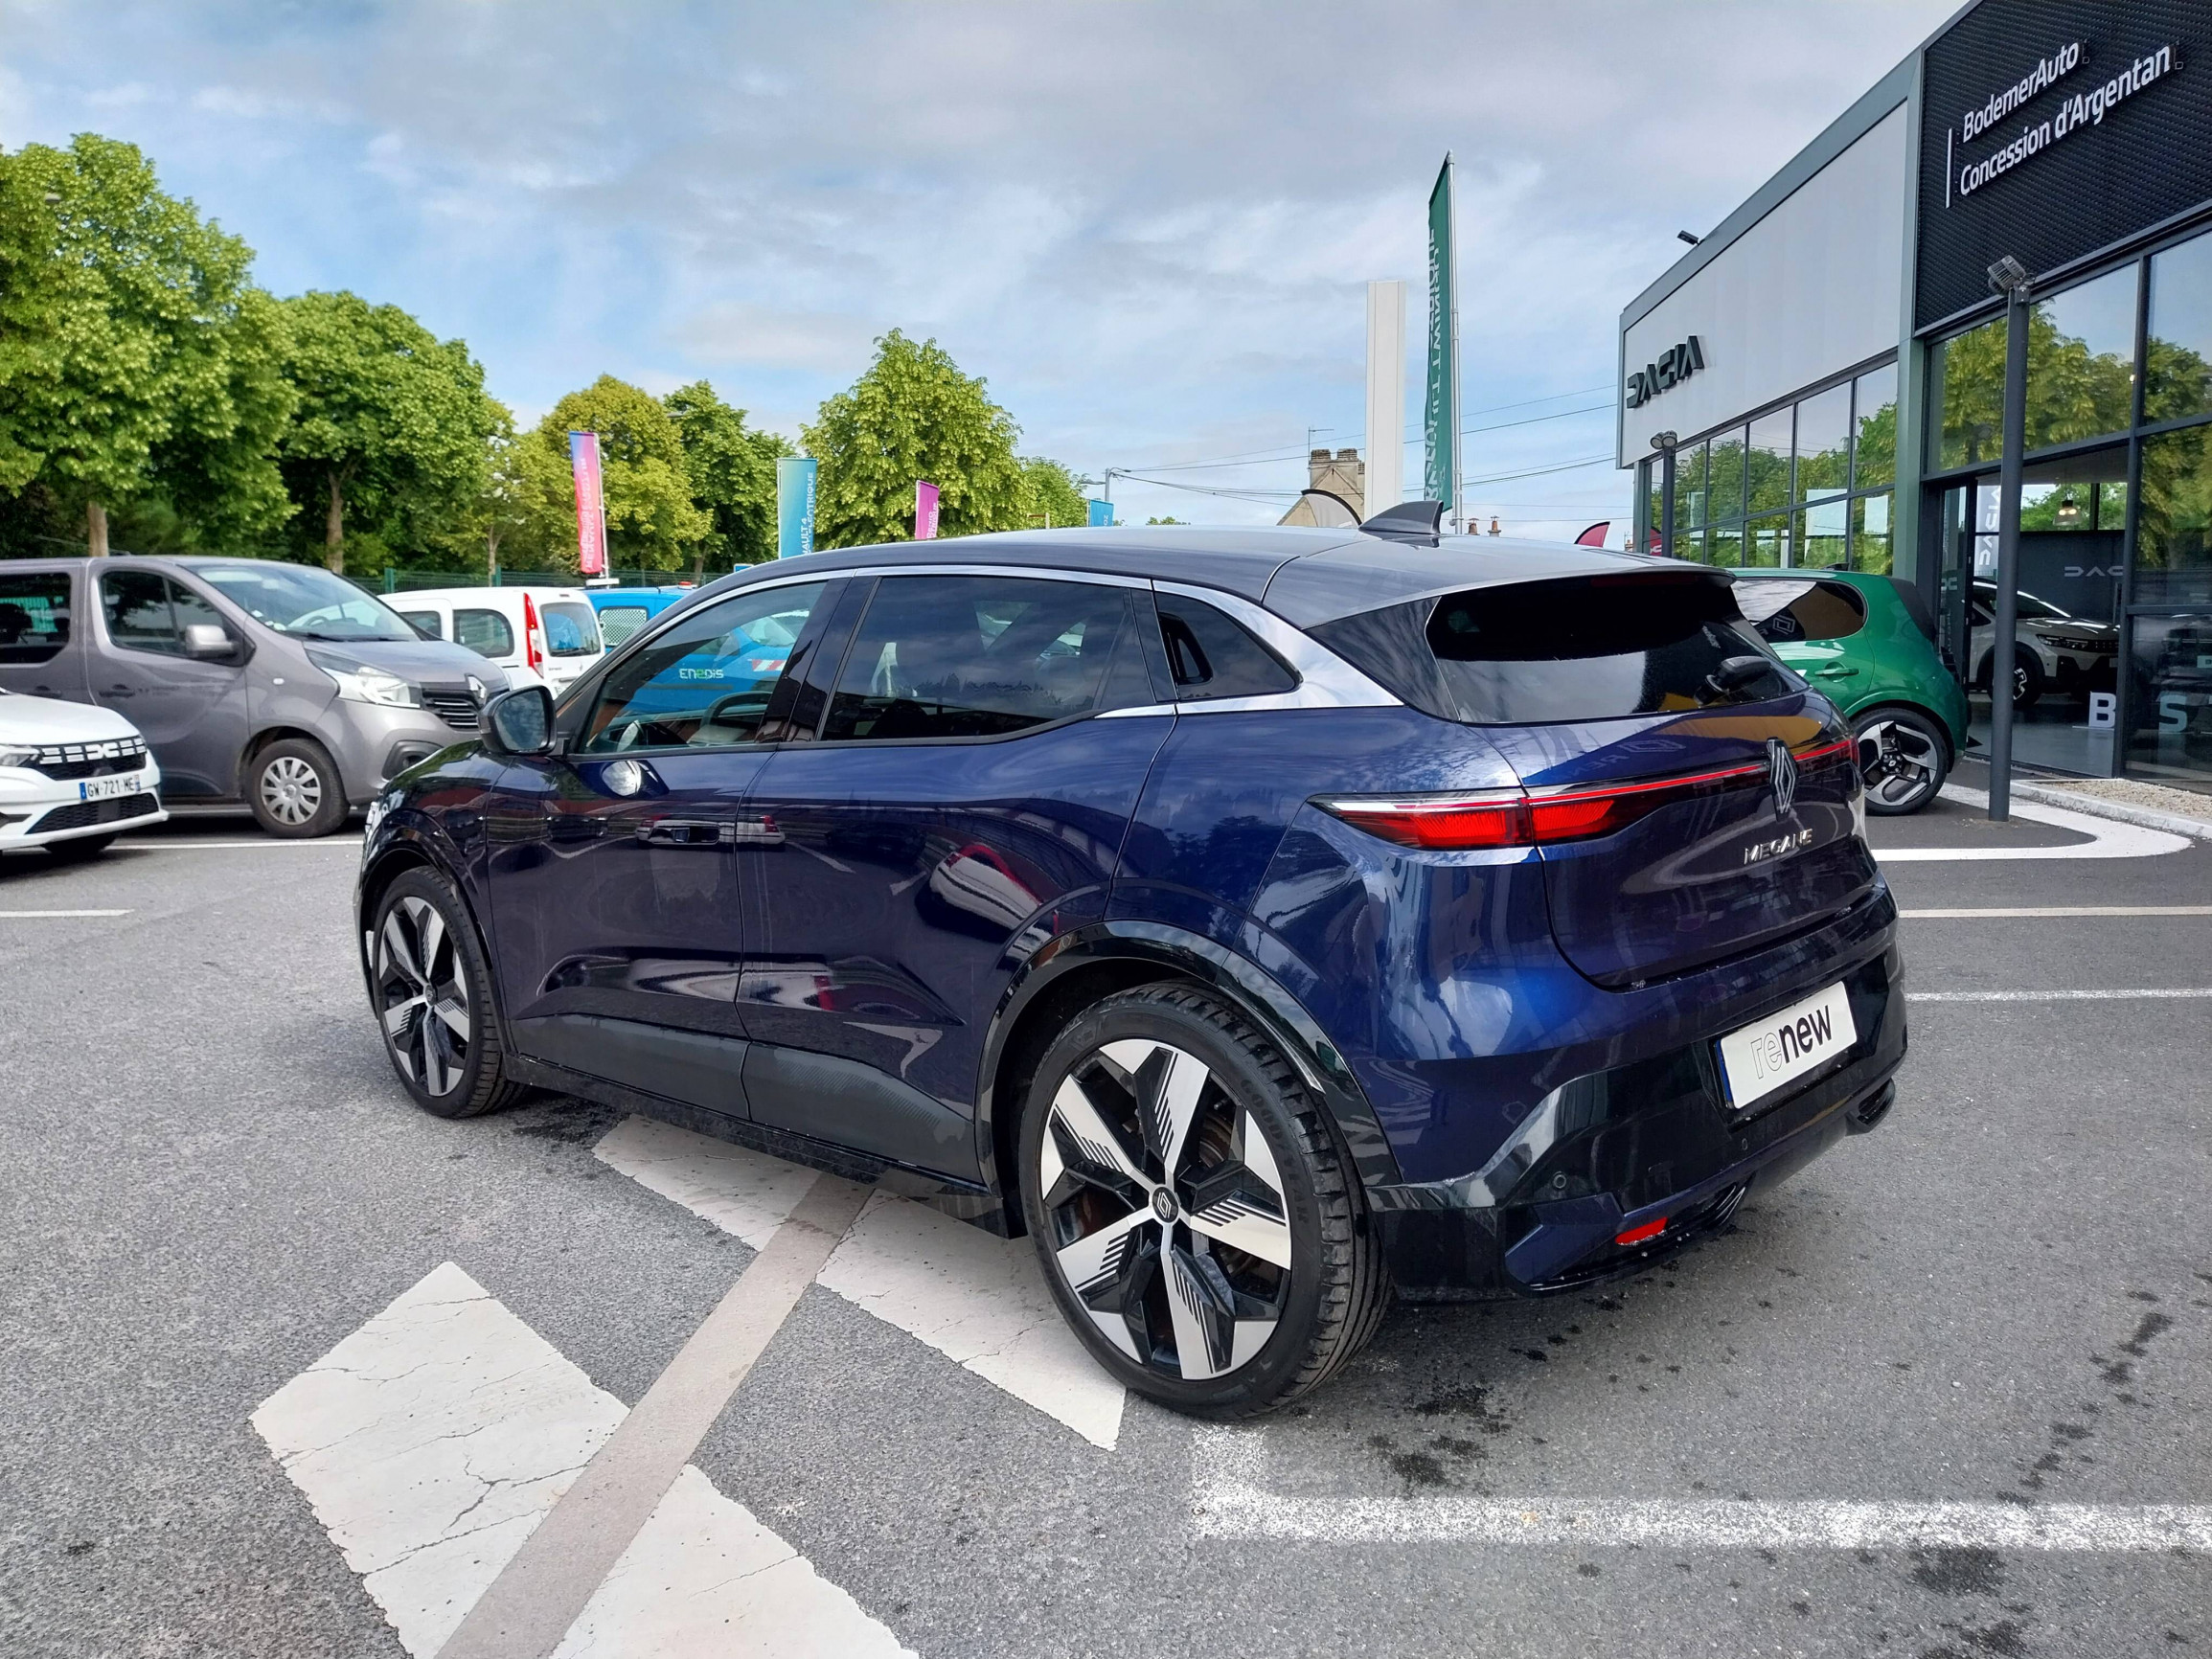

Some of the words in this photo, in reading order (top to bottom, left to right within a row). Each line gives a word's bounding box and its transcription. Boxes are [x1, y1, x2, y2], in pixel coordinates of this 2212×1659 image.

[1960, 122, 2051, 195] Concession
[2055, 46, 2170, 139] d'Argentan
[1963, 42, 2079, 143] BodemerAuto
[1627, 335, 1705, 408] DACIA
[2064, 565, 2124, 577] DAC
[1744, 829, 1813, 865] MEGANE
[1750, 1005, 1832, 1079] renew
